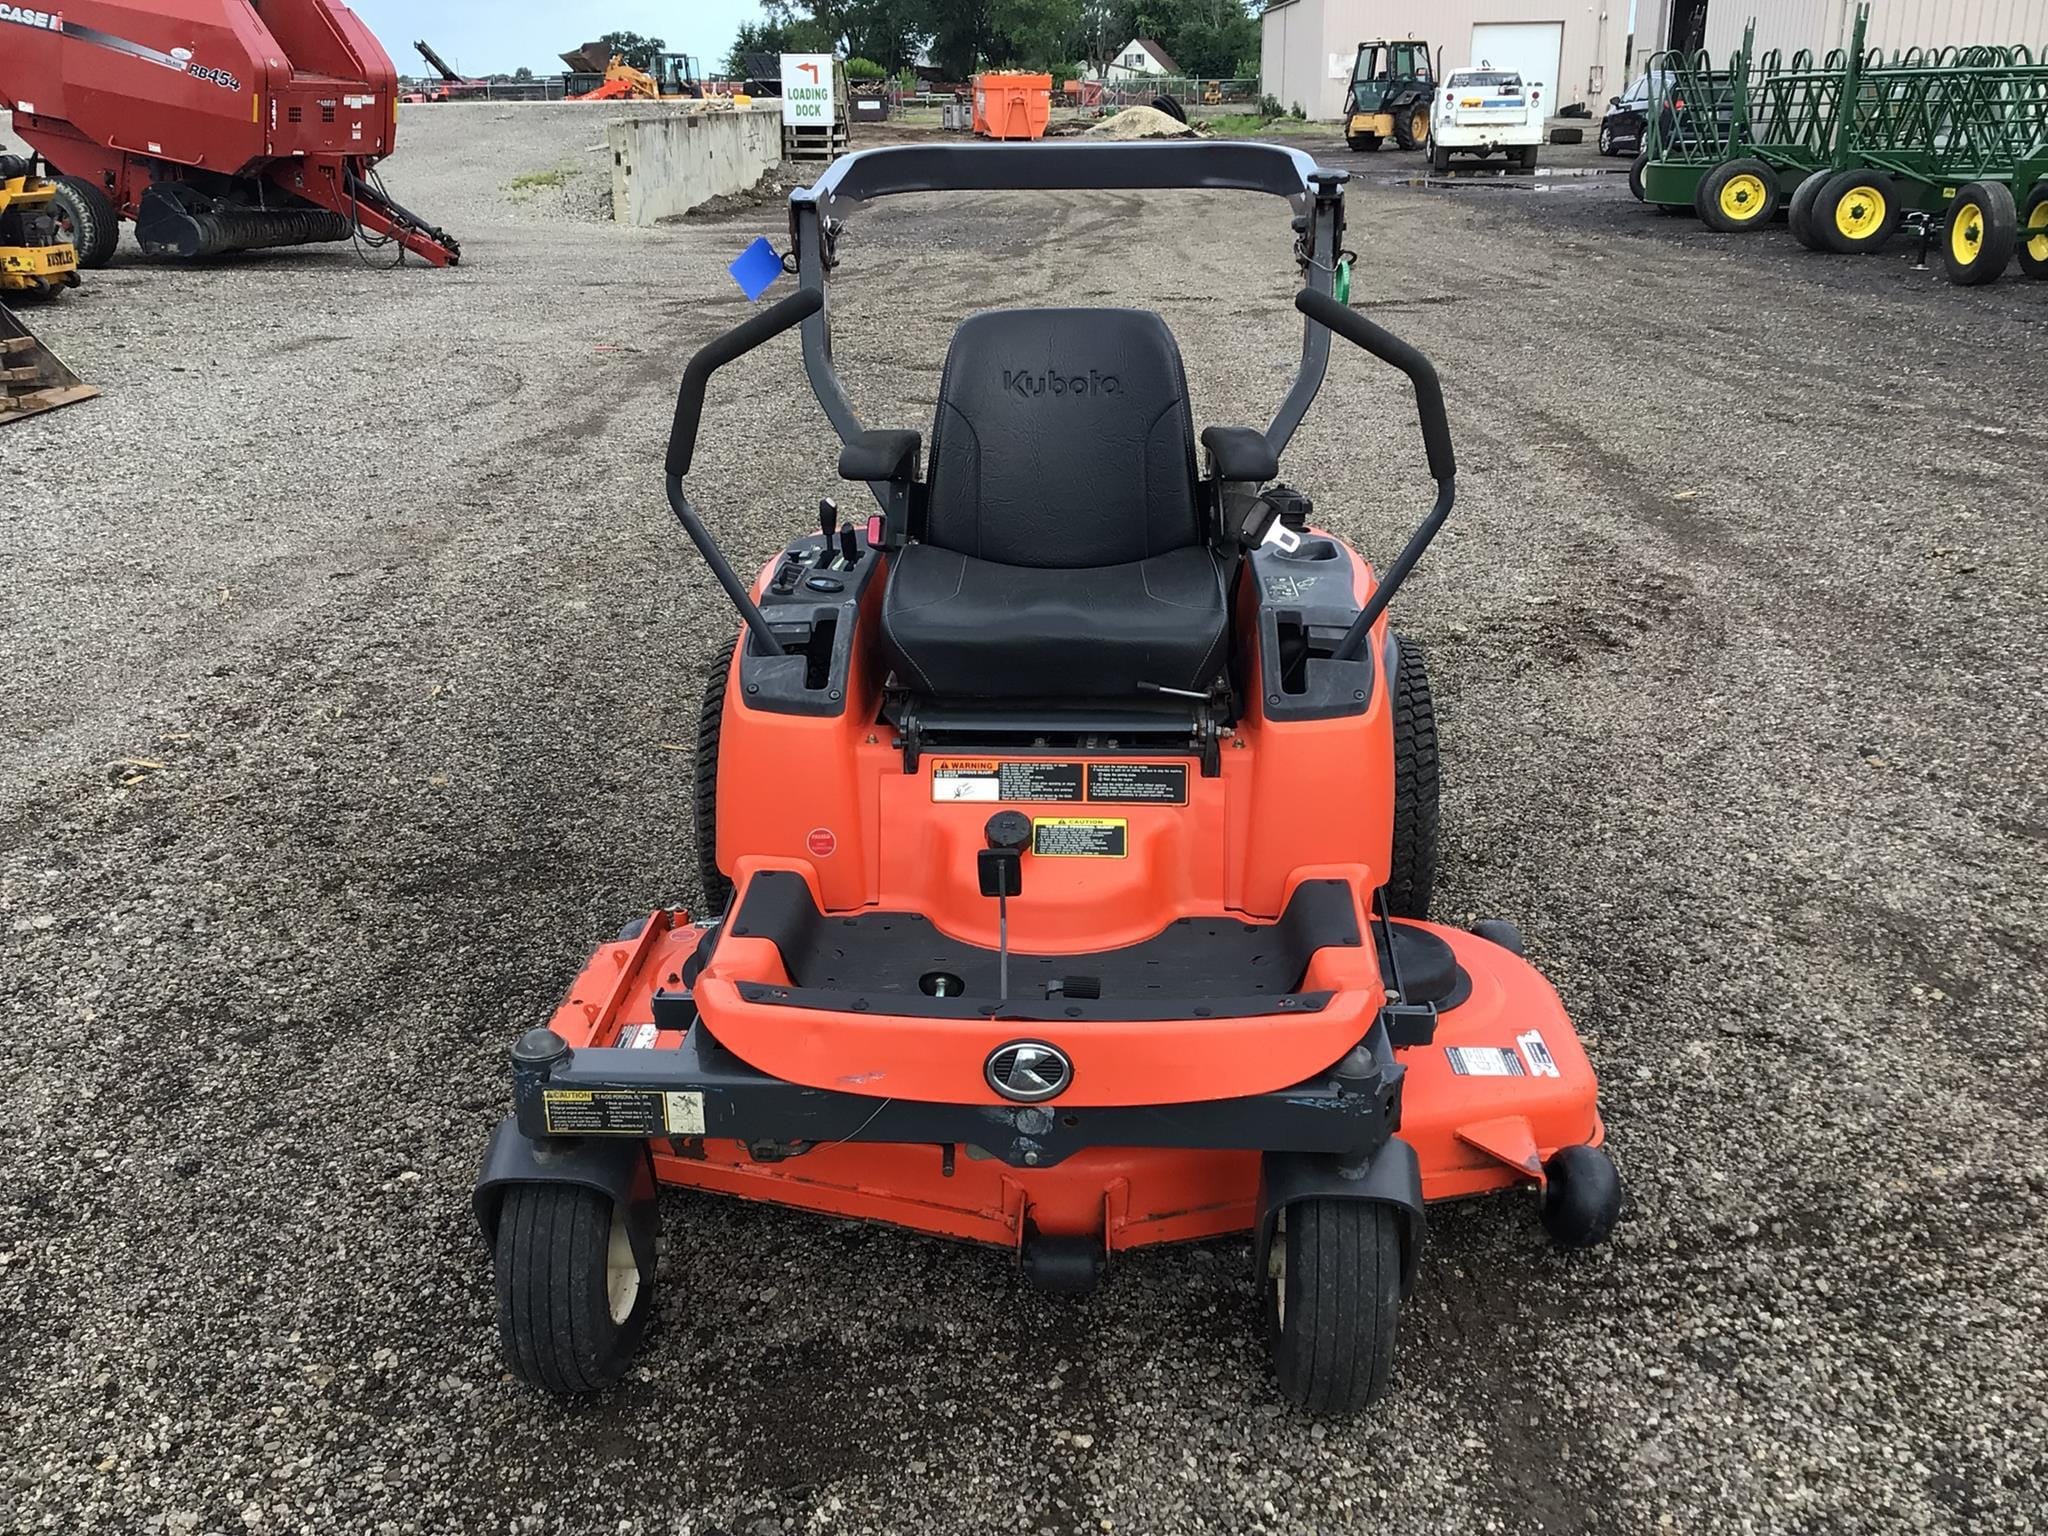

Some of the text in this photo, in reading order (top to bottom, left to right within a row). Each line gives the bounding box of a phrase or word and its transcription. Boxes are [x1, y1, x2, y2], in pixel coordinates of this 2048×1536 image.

[0, 3, 49, 28] CASE
[188, 62, 241, 92] RB454
[787, 88, 828, 100] LOADING
[796, 104, 821, 116] DOCK
[1003, 369, 1123, 398] Kubota
